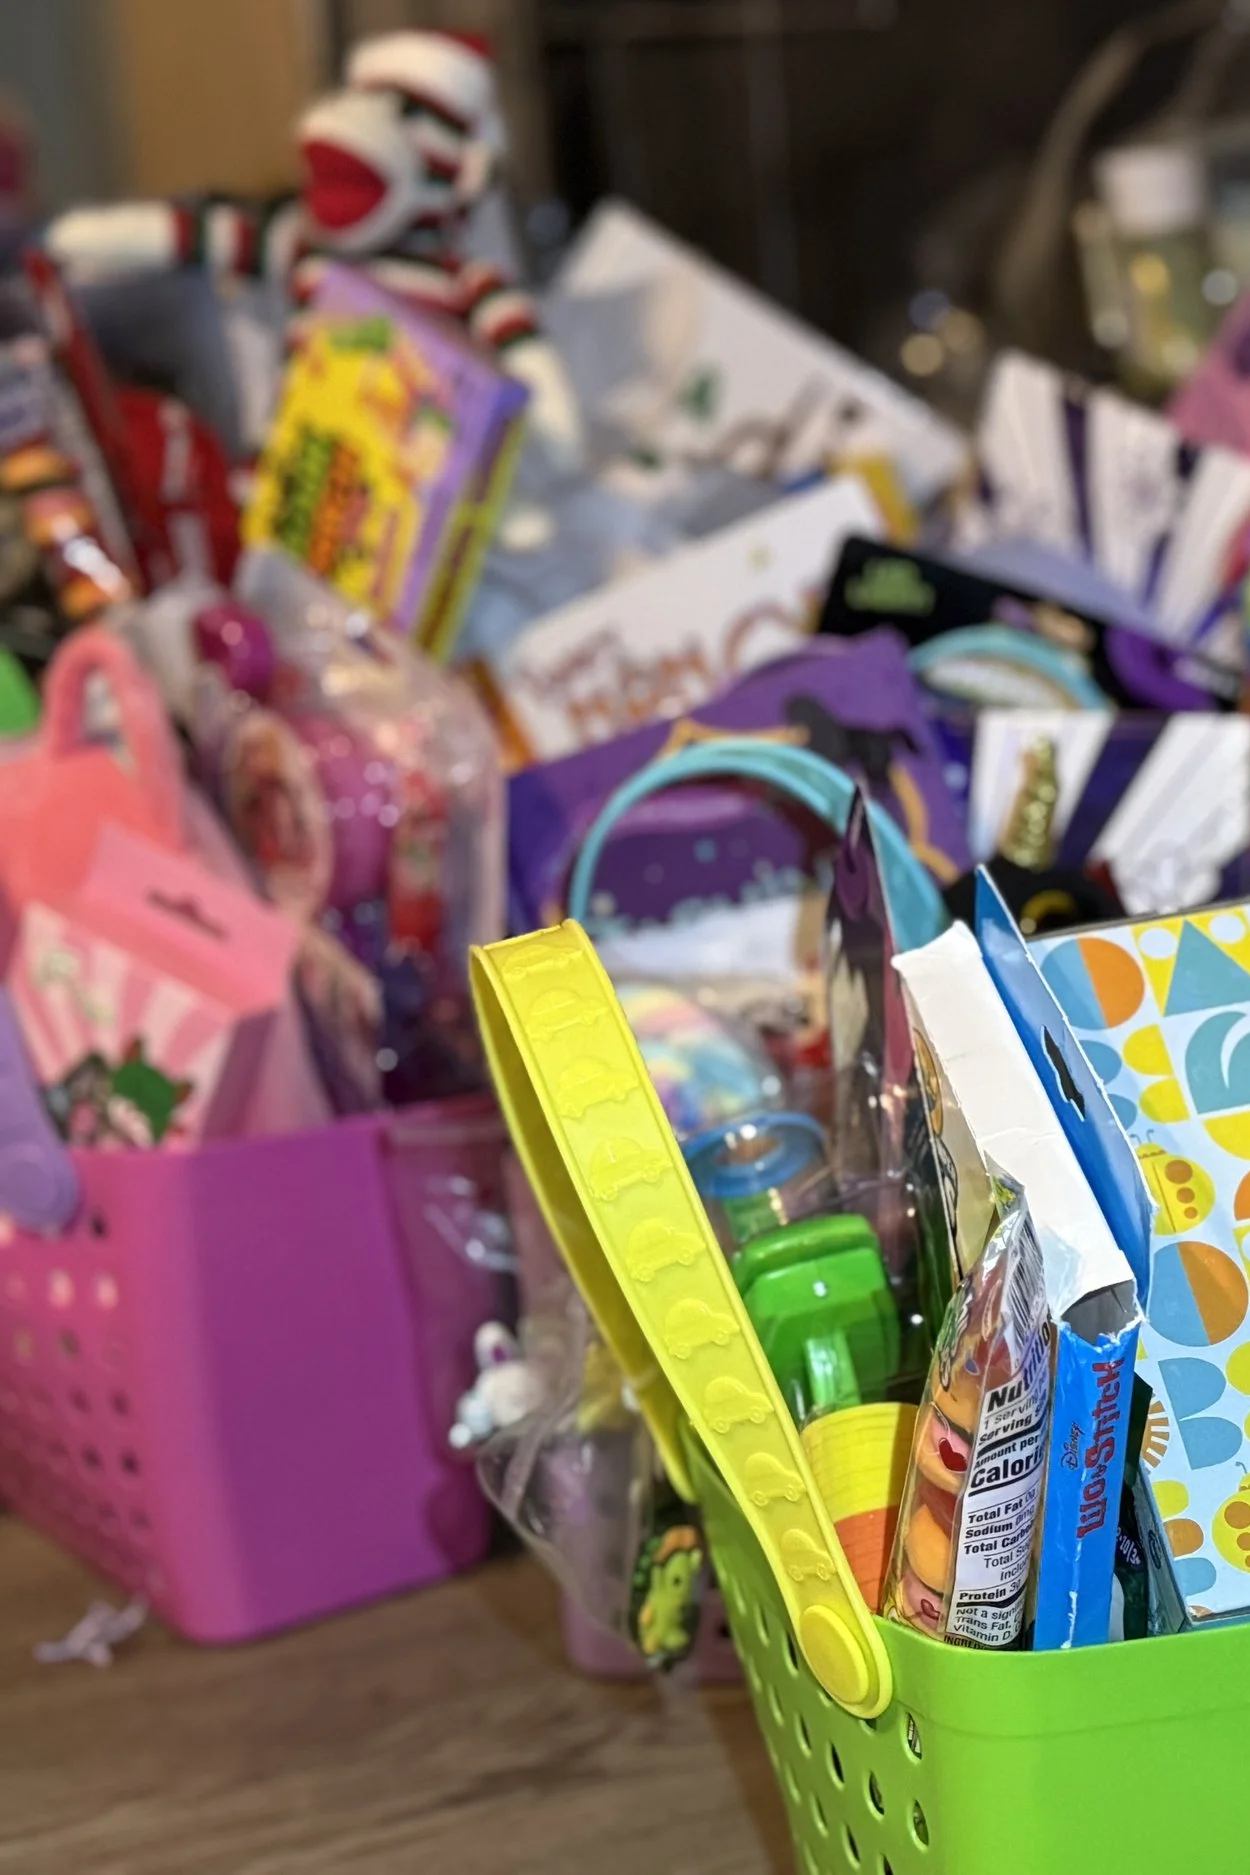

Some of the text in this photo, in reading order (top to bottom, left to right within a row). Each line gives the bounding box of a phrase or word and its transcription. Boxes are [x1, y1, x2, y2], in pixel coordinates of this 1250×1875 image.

[1020, 1434, 1040, 1452] per
[1060, 1421, 1085, 1471] Disney
[968, 1508, 1000, 1524] Total
[1004, 1498, 1023, 1515] Fat
[965, 1521, 1013, 1539] Sodium
[964, 1541, 998, 1555] Total
[983, 1552, 1013, 1569] Total
[959, 1587, 1006, 1601] Protein
[956, 1606, 978, 1616] Not
[980, 1609, 989, 1620] a
[955, 1615, 988, 1630] Trans
[953, 1624, 999, 1643] Vitamin
